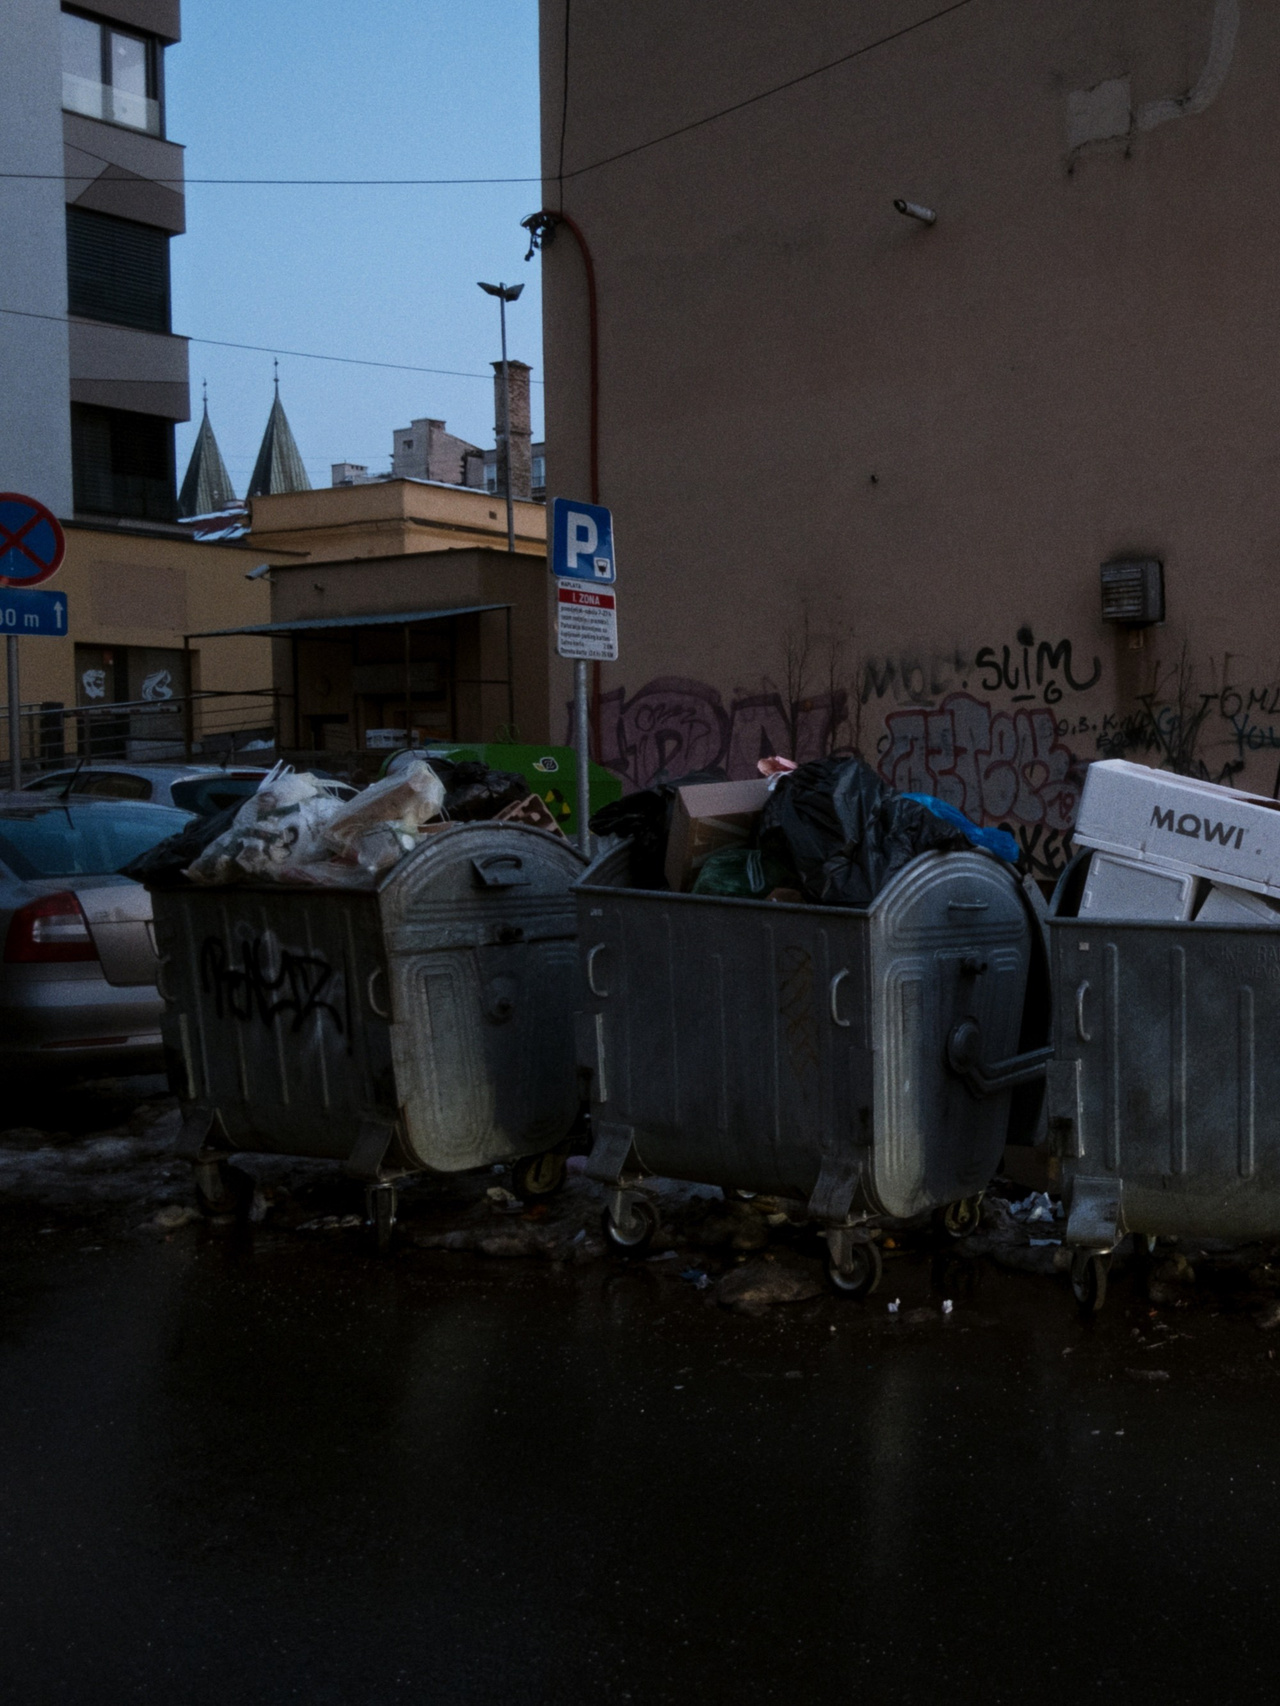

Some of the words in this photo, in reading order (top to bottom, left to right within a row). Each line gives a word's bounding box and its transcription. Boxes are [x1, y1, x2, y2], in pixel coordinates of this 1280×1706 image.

[566, 510, 599, 569] P
[579, 593, 601, 606] ZONA
[0, 607, 17, 627] 0
[24, 613, 40, 628] m
